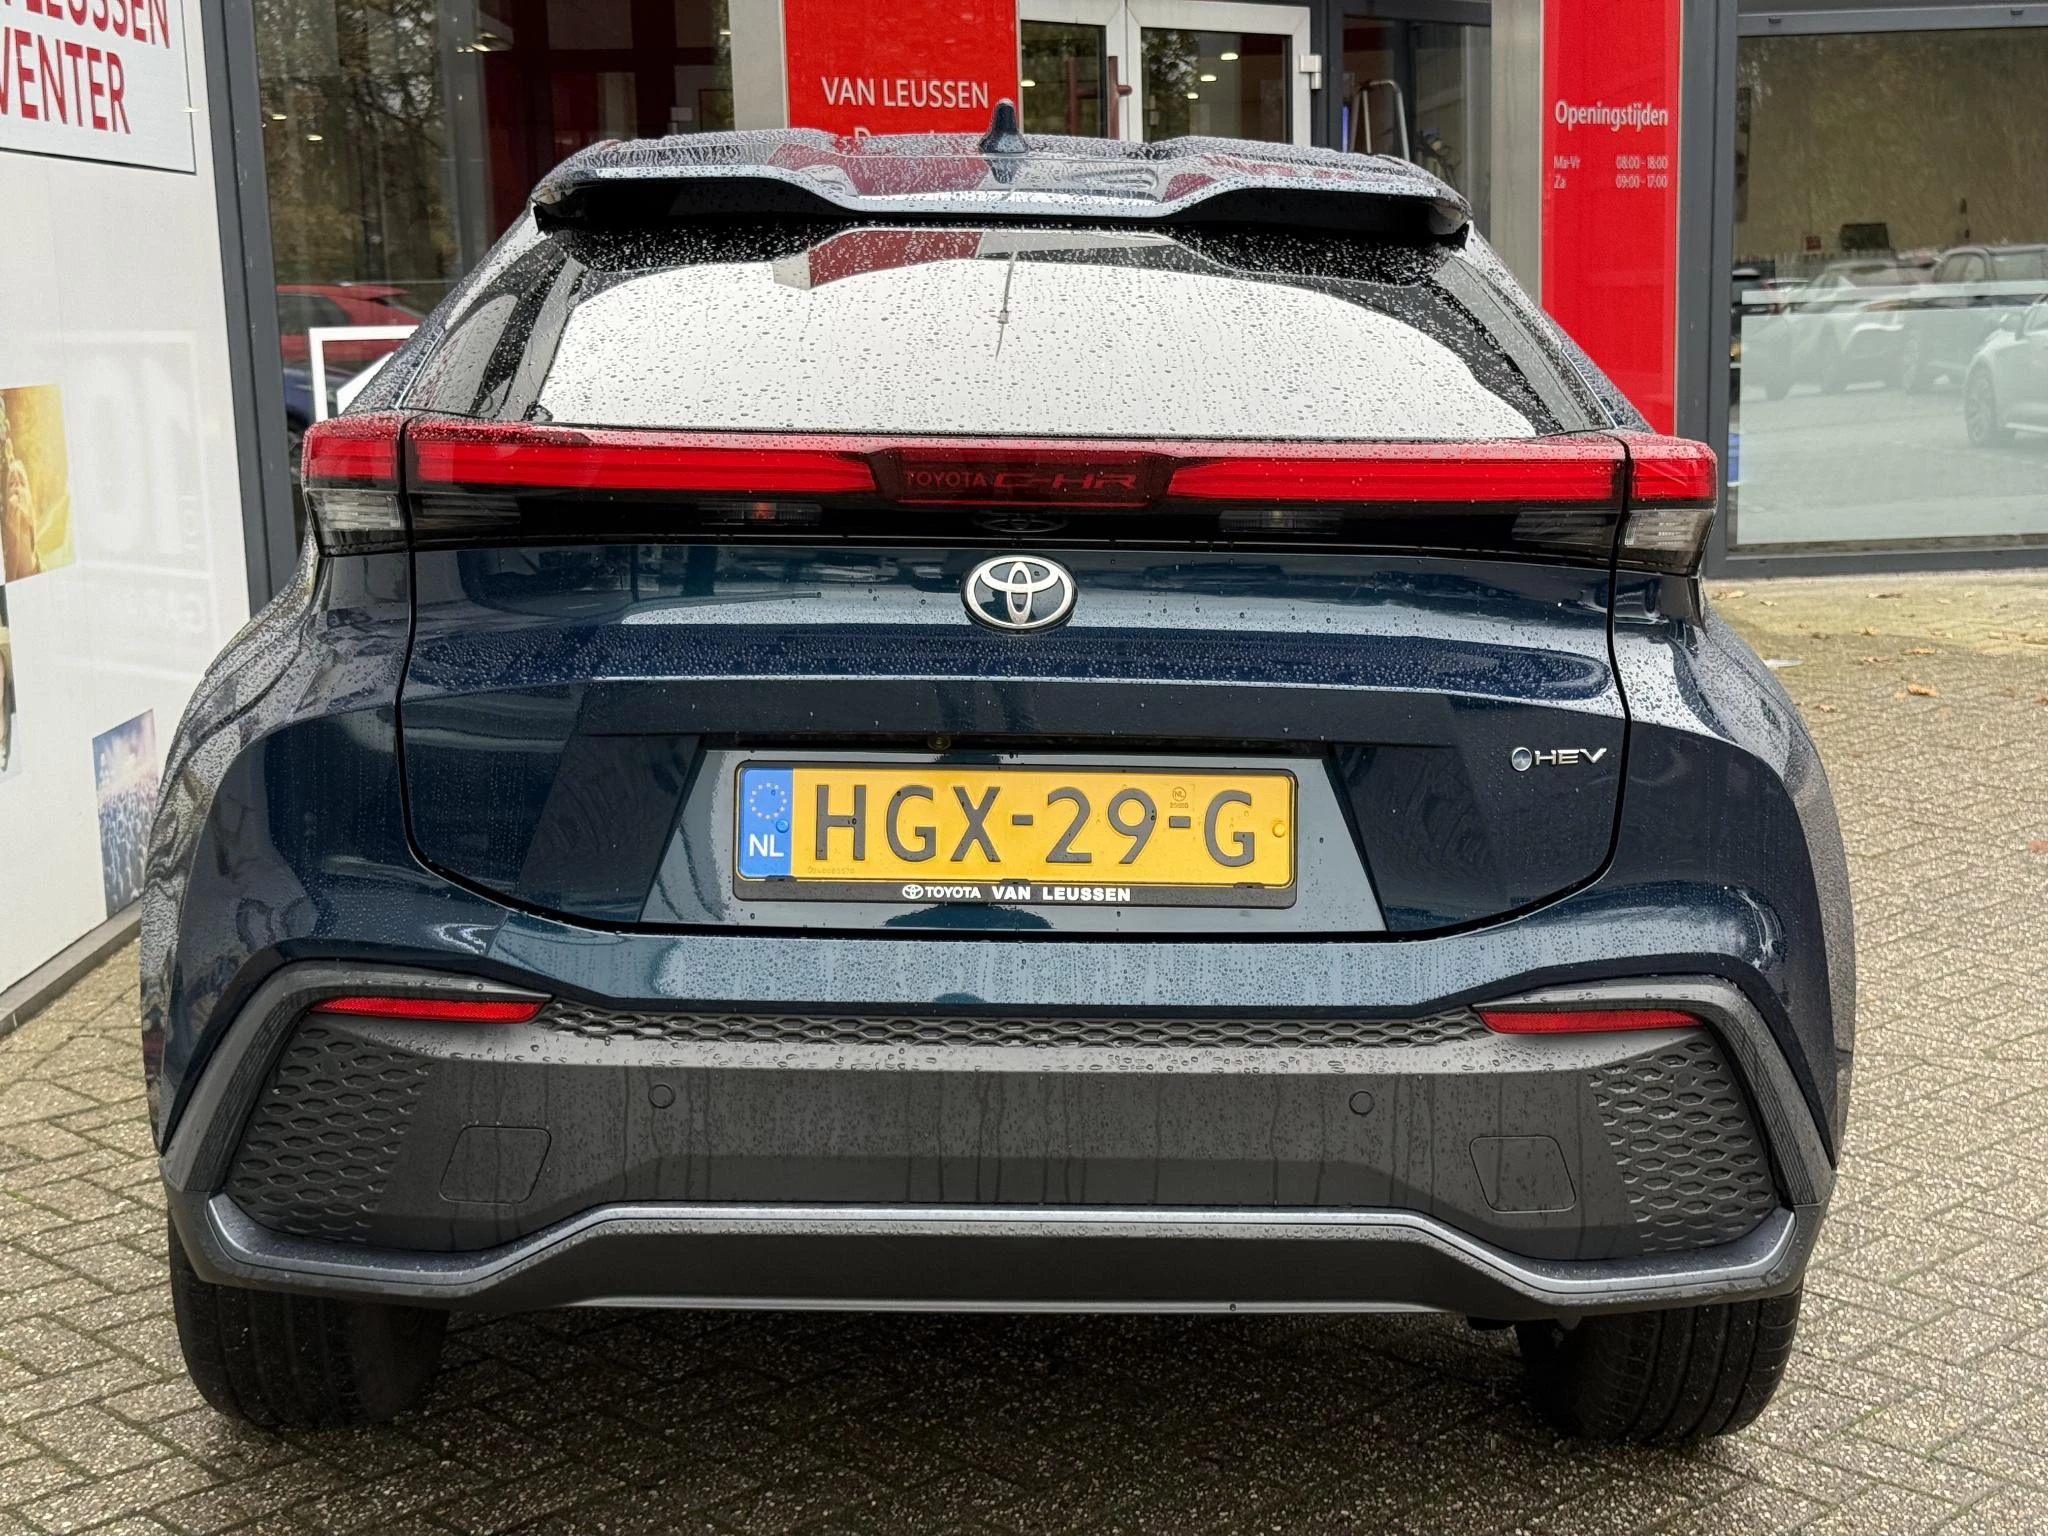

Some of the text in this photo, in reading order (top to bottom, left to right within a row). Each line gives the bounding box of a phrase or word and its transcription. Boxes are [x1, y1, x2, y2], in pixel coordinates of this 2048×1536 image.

[821, 77, 989, 108] VAN LEUSSEN
[1555, 100, 1669, 132] Openingstijden
[905, 471, 1137, 489] TOYOTA C-HR
[1534, 748, 1608, 765] HEV
[815, 784, 1255, 867] HGX-29-G
[749, 833, 784, 857] NL
[924, 886, 1131, 902] TOYOTA VAN LEUSSEN
